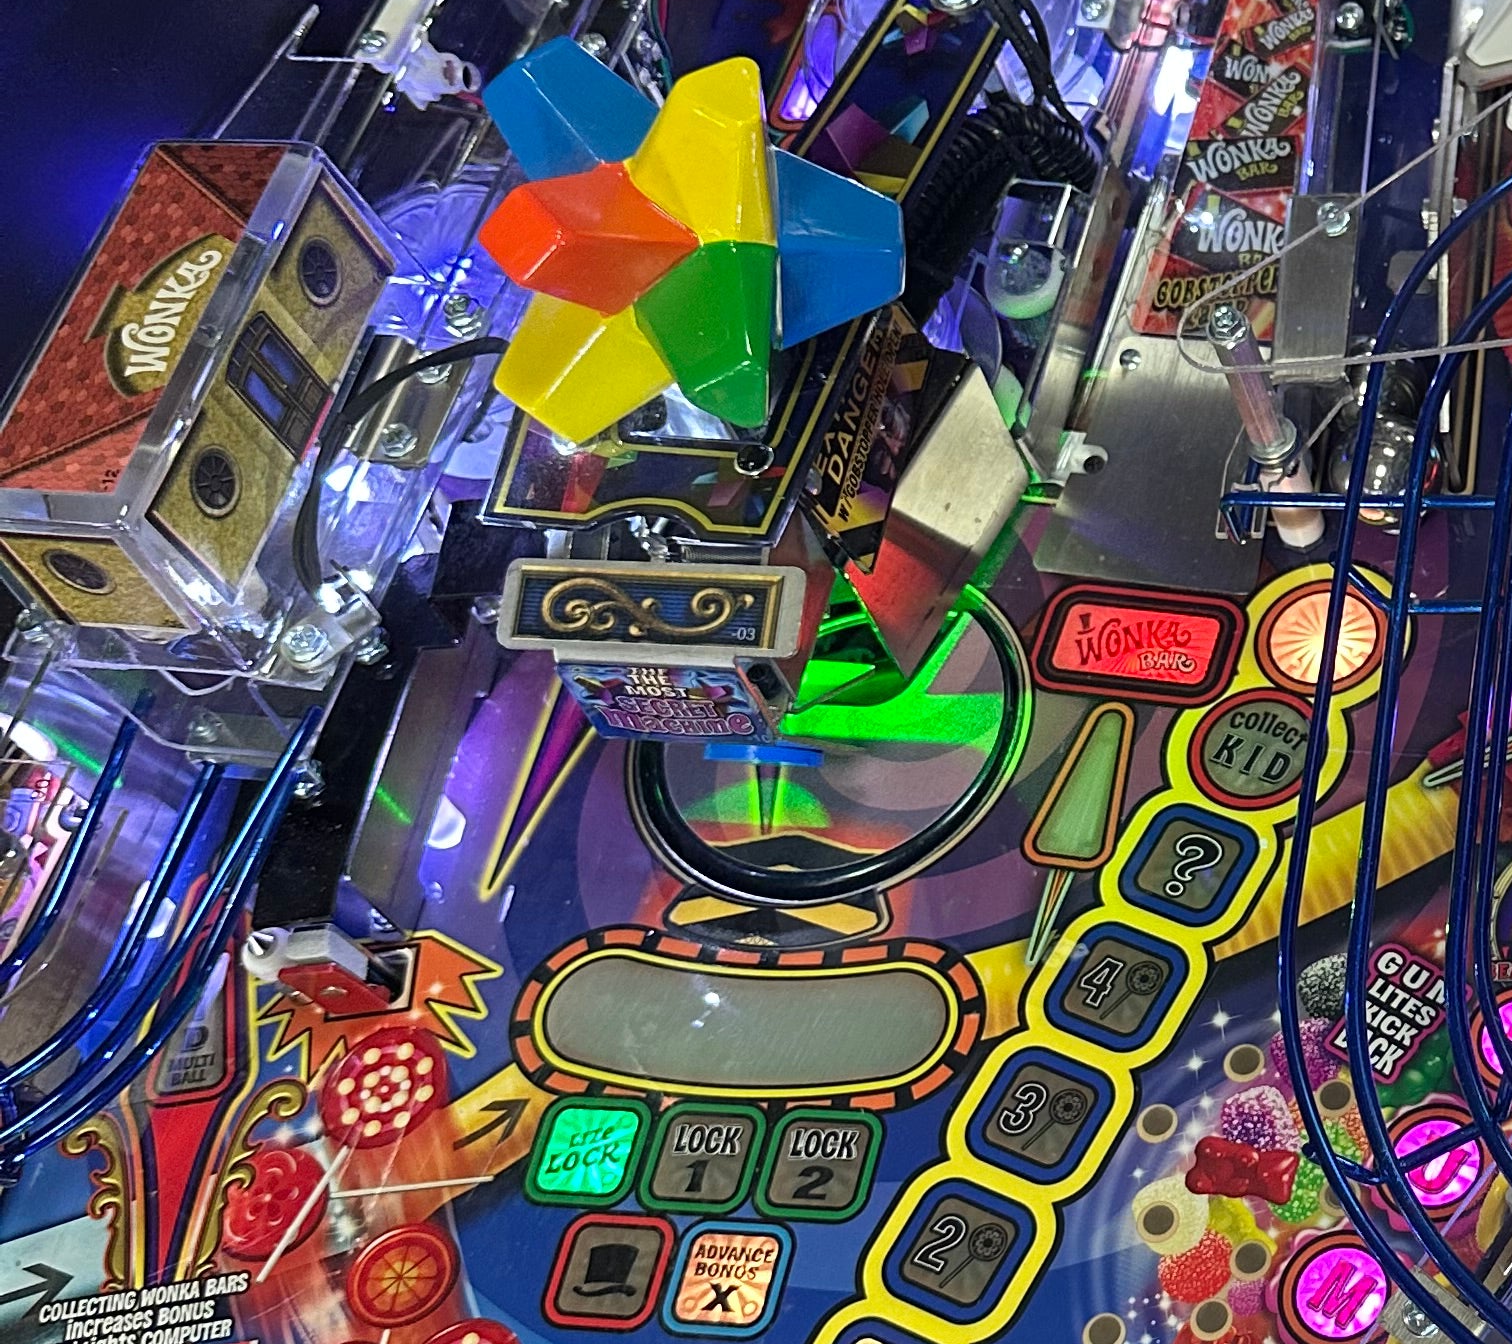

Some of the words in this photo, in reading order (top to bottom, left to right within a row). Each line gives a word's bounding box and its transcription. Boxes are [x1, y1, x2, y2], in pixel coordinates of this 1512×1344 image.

[1260, 6, 1315, 50] WONKA
[1224, 54, 1284, 84] WON
[1239, 71, 1302, 137] WONKA
[1186, 137, 1292, 183] WONKA
[1235, 161, 1280, 181] BAR
[1196, 207, 1285, 254] WONK
[121, 249, 225, 378] WONKA
[826, 329, 886, 485] DANGER
[843, 405, 881, 500] GOBSTOPPER
[731, 626, 757, 642] -03
[1075, 617, 1192, 662] WONKA
[626, 674, 673, 686] THE
[1138, 650, 1196, 674] BAR
[614, 696, 718, 718] SECRET
[624, 685, 688, 698] MOST
[1209, 748, 1294, 784] KID
[1079, 958, 1121, 1009] 4
[1367, 977, 1437, 1027] LITES
[1365, 1000, 1420, 1047] KICK
[998, 1082, 1049, 1136] 3
[673, 1123, 744, 1156] LOCK
[788, 1127, 860, 1160] LOCK
[544, 1143, 622, 1175] LOCK
[682, 1159, 709, 1193] 1
[791, 1165, 836, 1201] 2
[693, 1243, 776, 1264] ADVANCE
[913, 1213, 968, 1273] 2
[693, 1261, 760, 1282] BONUS
[37, 1290, 137, 1323] COLLECTING
[139, 1280, 202, 1309] WONKA
[204, 1273, 250, 1296] BARS
[699, 1280, 742, 1313] X
[1306, 1258, 1379, 1331] M
[156, 1299, 216, 1328] BONUS
